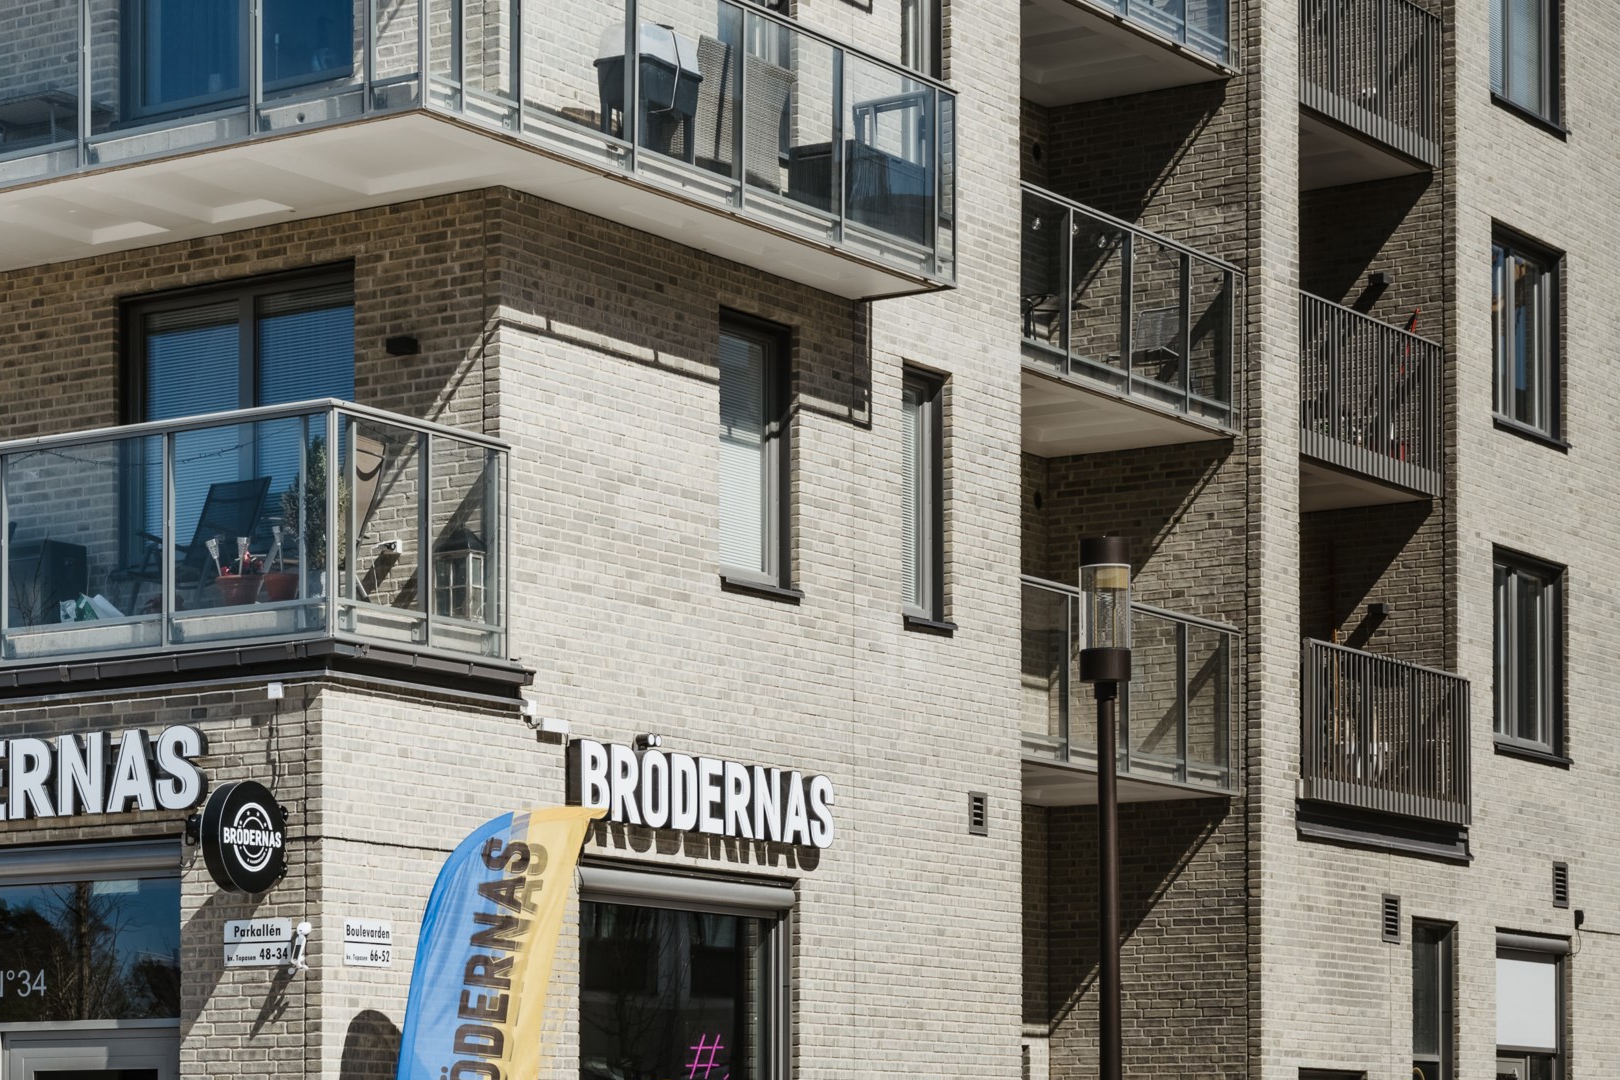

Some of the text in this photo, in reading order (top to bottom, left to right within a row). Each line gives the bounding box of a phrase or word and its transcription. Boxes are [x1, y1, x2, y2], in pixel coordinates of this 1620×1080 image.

[580, 733, 835, 849] BRÖDERNAS
[223, 825, 282, 848] BRÖDERNAS
[233, 923, 282, 938] Parkallén
[346, 925, 390, 939] Boulevarden
[259, 947, 289, 960] 48-34
[369, 950, 390, 963] 66-52
